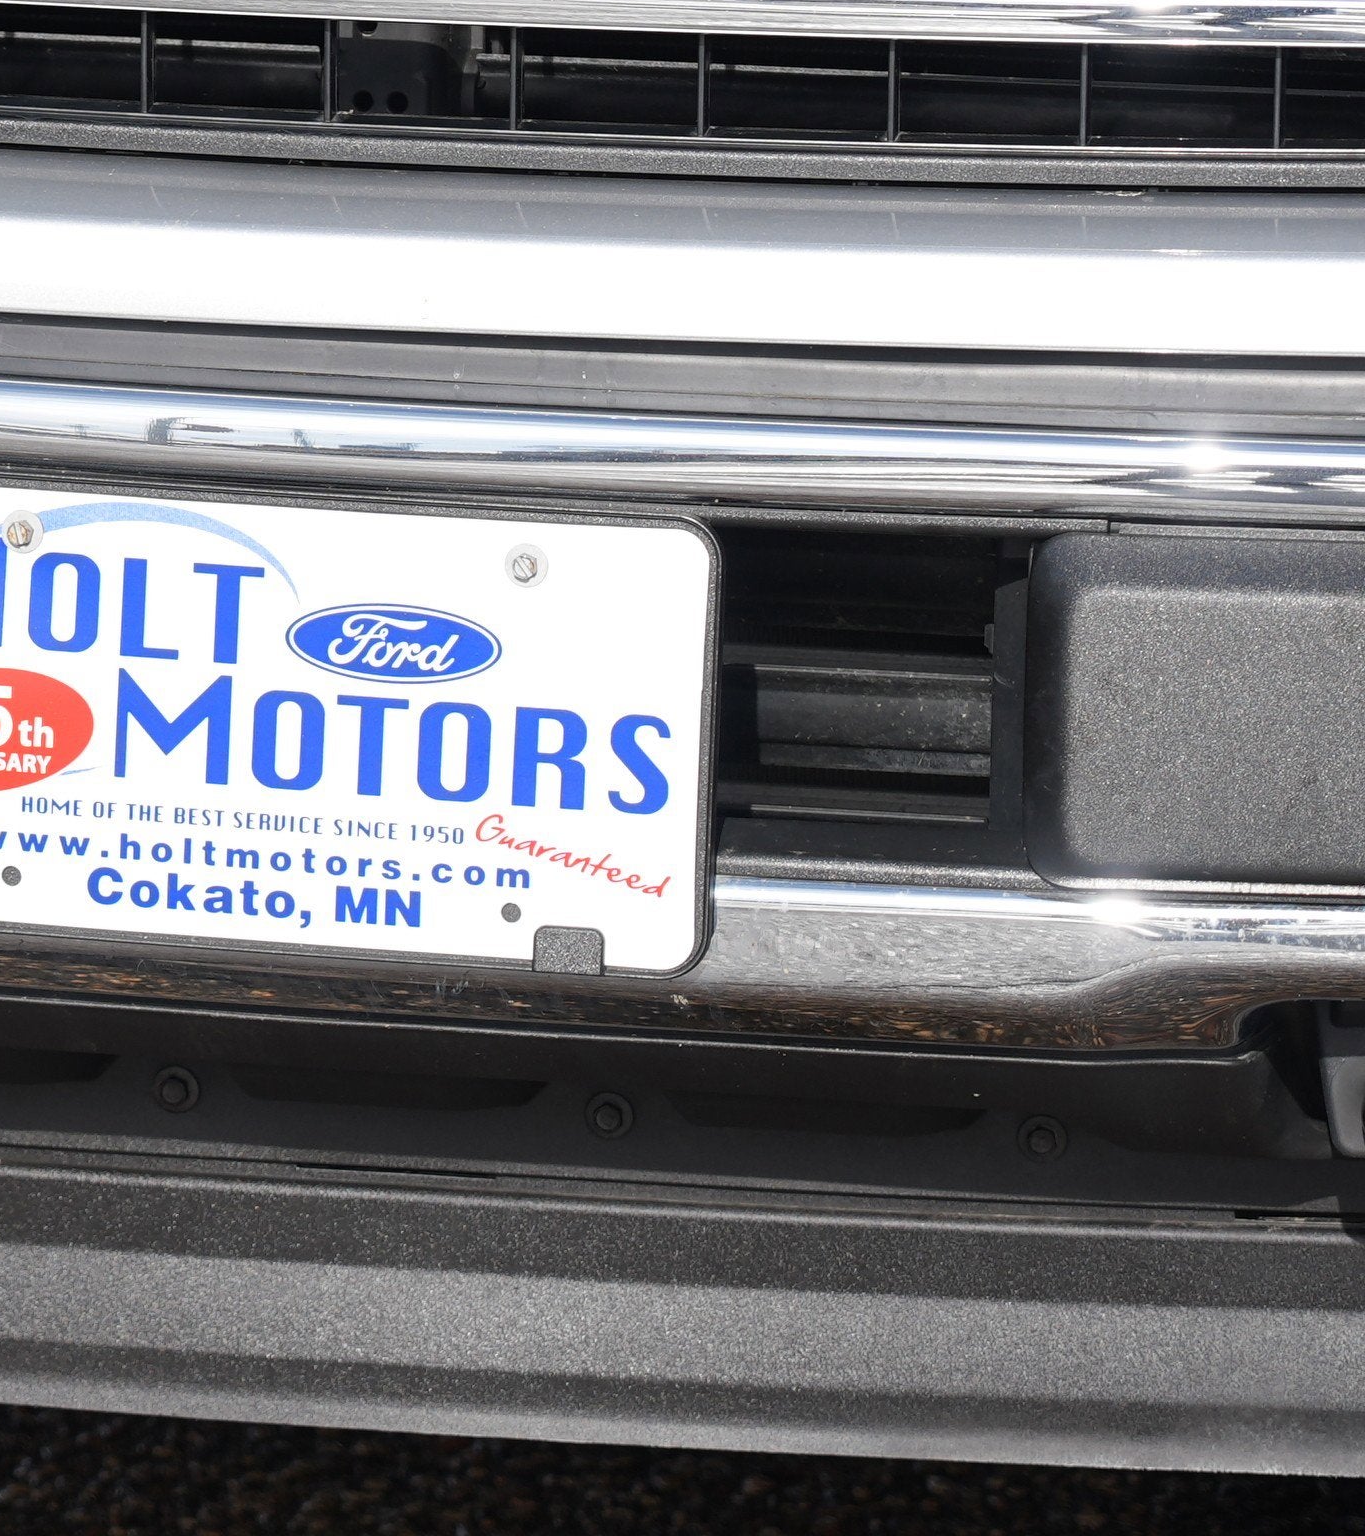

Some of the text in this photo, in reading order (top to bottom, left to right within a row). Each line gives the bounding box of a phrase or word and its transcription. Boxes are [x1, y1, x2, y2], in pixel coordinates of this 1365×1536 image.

[327, 613, 460, 673] Ford
[114, 669, 672, 815] MOTORS
[21, 796, 464, 845] HOME OF THE BEST SERVICE SINCE 1950
[475, 813, 672, 898] Guaranteed
[88, 867, 422, 928] Cokato, MN
